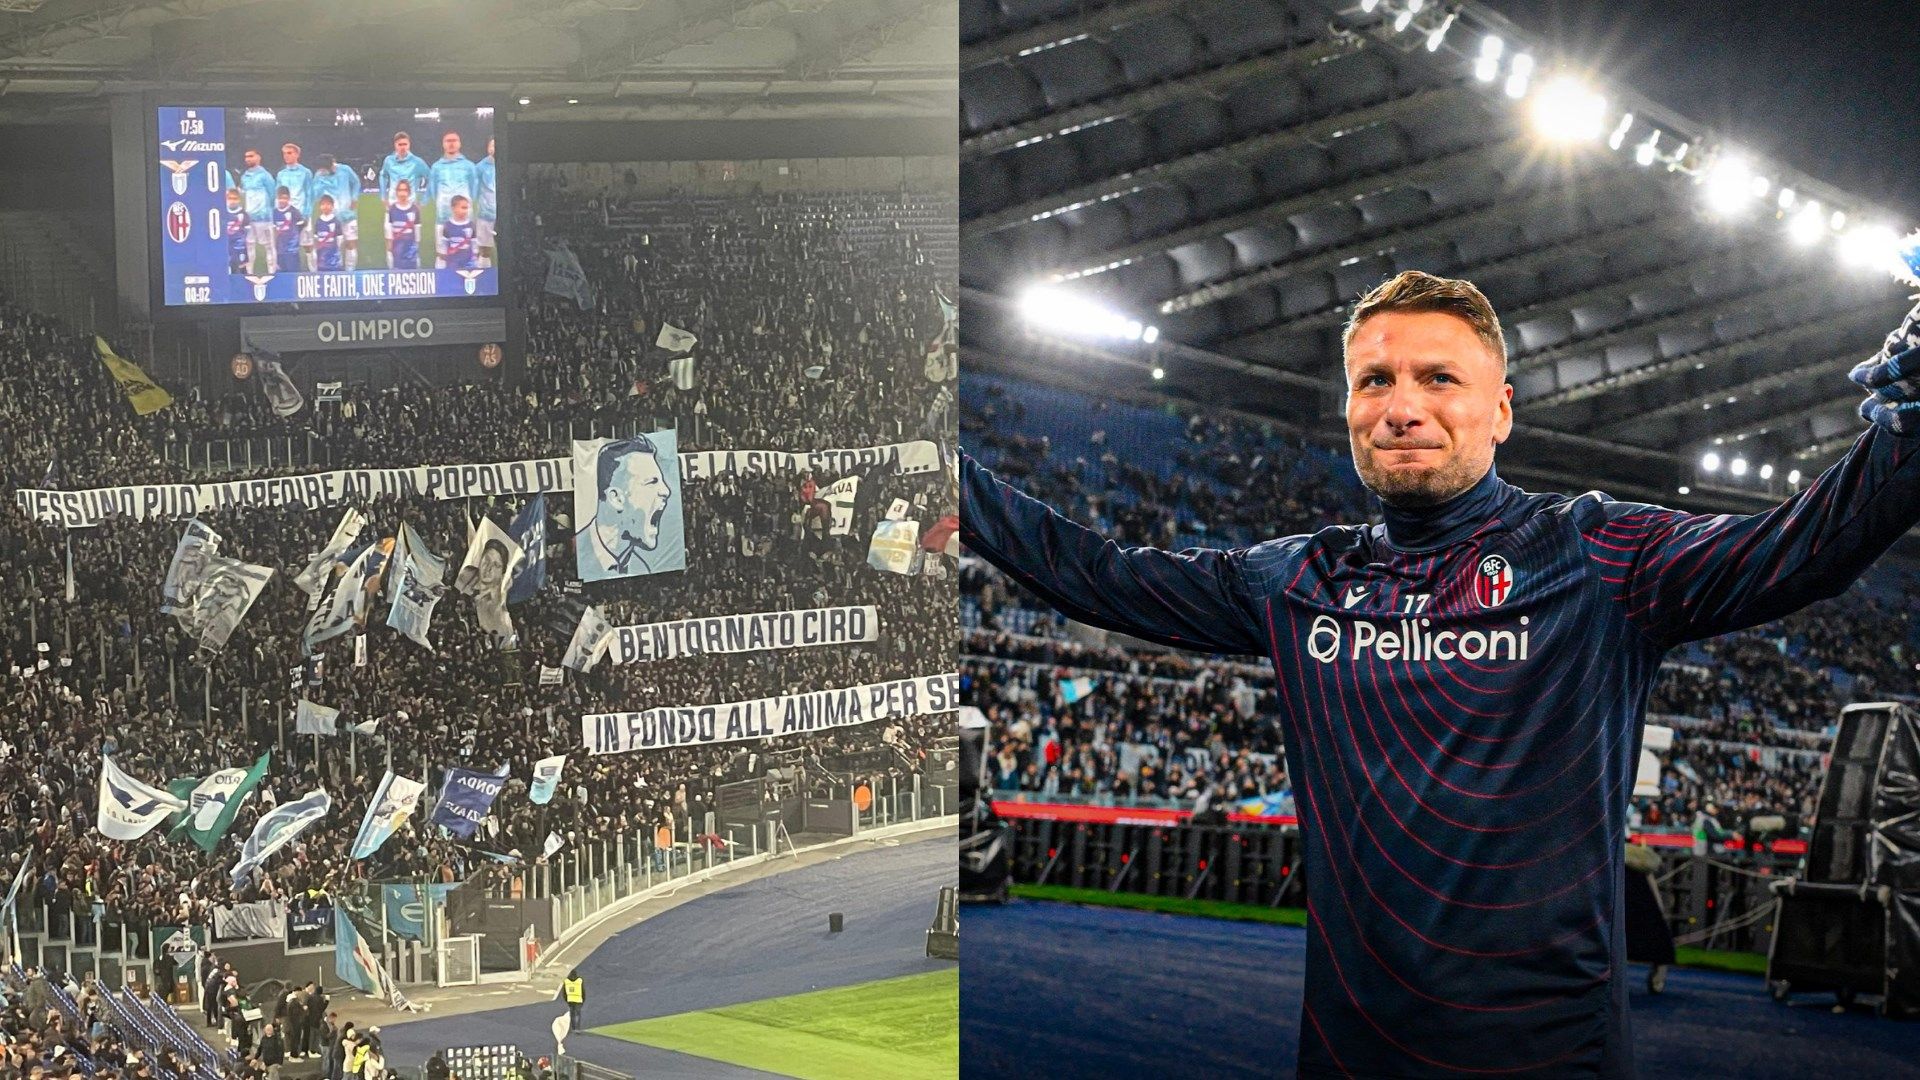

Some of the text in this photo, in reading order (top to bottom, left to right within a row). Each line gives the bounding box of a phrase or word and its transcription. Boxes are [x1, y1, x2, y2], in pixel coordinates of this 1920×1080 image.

[207, 161, 219, 193] 0
[208, 208, 220, 240] 0
[297, 271, 436, 300] ONE FAITH, ONE PASSION
[317, 318, 433, 342] OLIMPICO
[341, 471, 371, 502] AD
[427, 462, 528, 499] POPOLO
[536, 459, 563, 492] DI
[1483, 559, 1501, 573] BFC
[1404, 593, 1430, 614] 17
[621, 607, 866, 662] BENTORNATO CIRO
[1353, 616, 1530, 661] Pelliconi
[595, 715, 619, 752] IN
[628, 708, 716, 749] FONDO
[726, 688, 863, 740] ALL'ANIMA
[870, 681, 918, 718] PER
